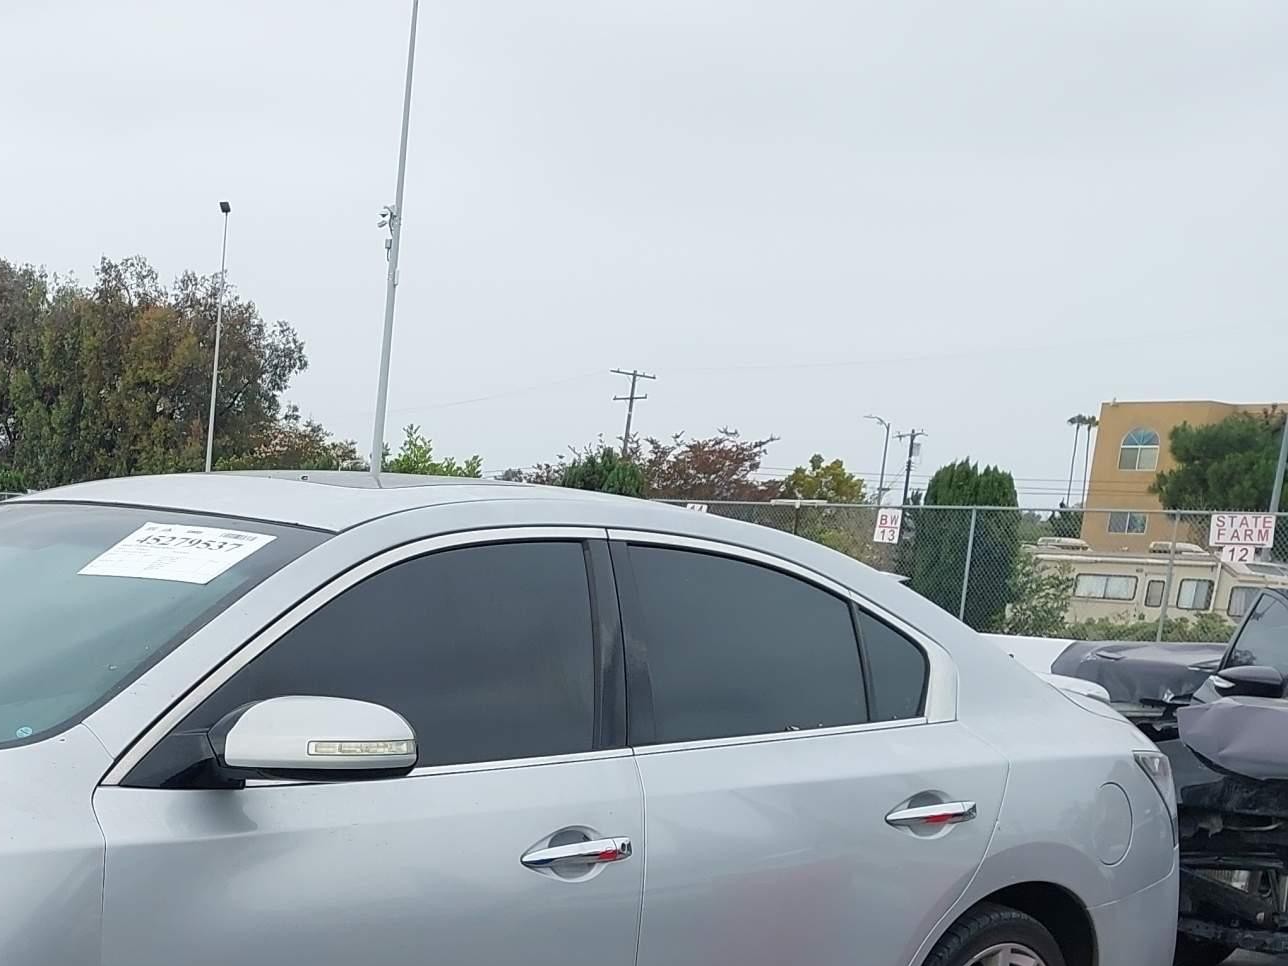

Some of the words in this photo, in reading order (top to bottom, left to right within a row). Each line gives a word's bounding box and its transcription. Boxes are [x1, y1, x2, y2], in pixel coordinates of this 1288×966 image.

[879, 514, 900, 526] BW
[1215, 515, 1273, 529] STATE
[879, 529, 896, 542] 13
[1216, 528, 1270, 542] FARM
[136, 534, 243, 552] 45279537
[1228, 547, 1249, 562] 12
